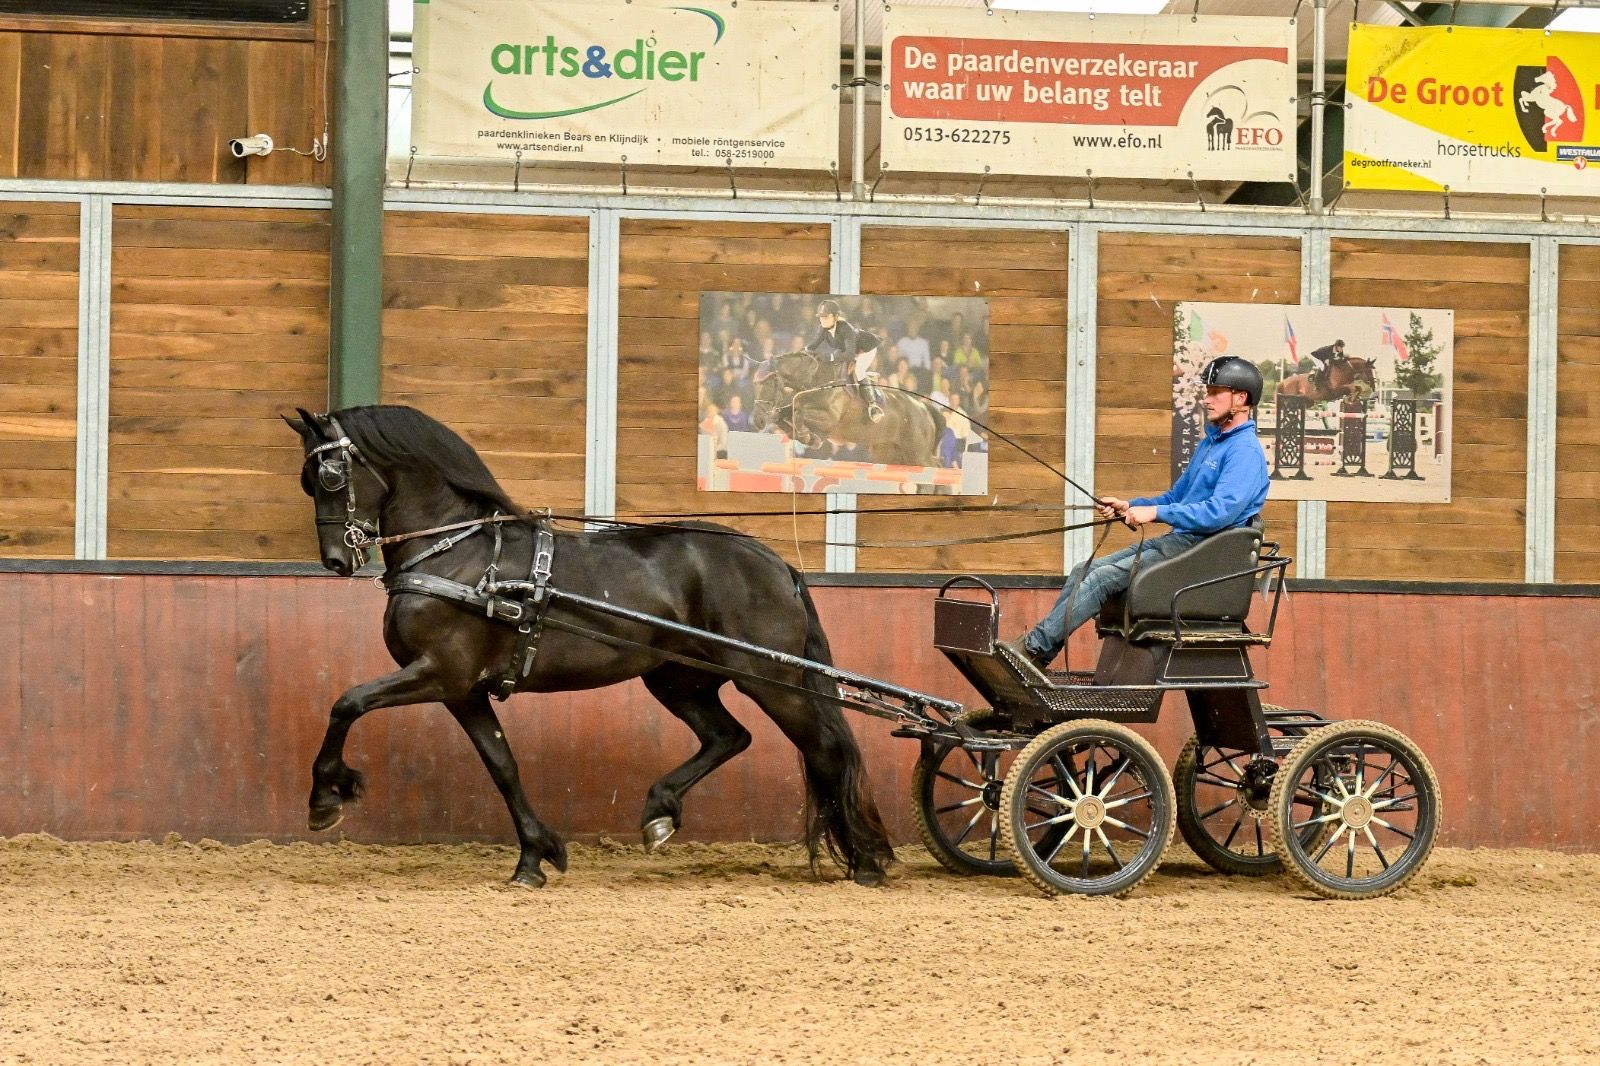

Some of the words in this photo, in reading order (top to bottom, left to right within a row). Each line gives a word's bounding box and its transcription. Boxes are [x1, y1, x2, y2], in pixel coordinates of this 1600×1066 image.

[490, 36, 706, 81] arts&dier
[904, 46, 937, 70] De
[948, 50, 1198, 78] paardenverzekeraar
[903, 80, 966, 101] waar
[976, 83, 1013, 102] uw
[1023, 80, 1110, 111] belang
[1119, 84, 1162, 107] telt
[1367, 76, 1407, 104] De
[1417, 77, 1504, 107] Groot
[477, 130, 561, 141] paardenklinieken
[563, 132, 592, 142] Bears
[609, 134, 649, 145] Klijndijk
[672, 137, 710, 146] mobiele
[713, 138, 785, 149] röntgenservice
[904, 127, 1011, 145] 0513-622275
[1073, 134, 1162, 149] www.efo.nl
[1235, 127, 1283, 146] EFO
[497, 141, 584, 152] www.artsendier.nl
[691, 149, 709, 157] tel.:
[715, 149, 775, 159] 058-2519000
[1437, 139, 1521, 158] horsetrucks
[1351, 157, 1432, 169] degrootfraneker.nl
